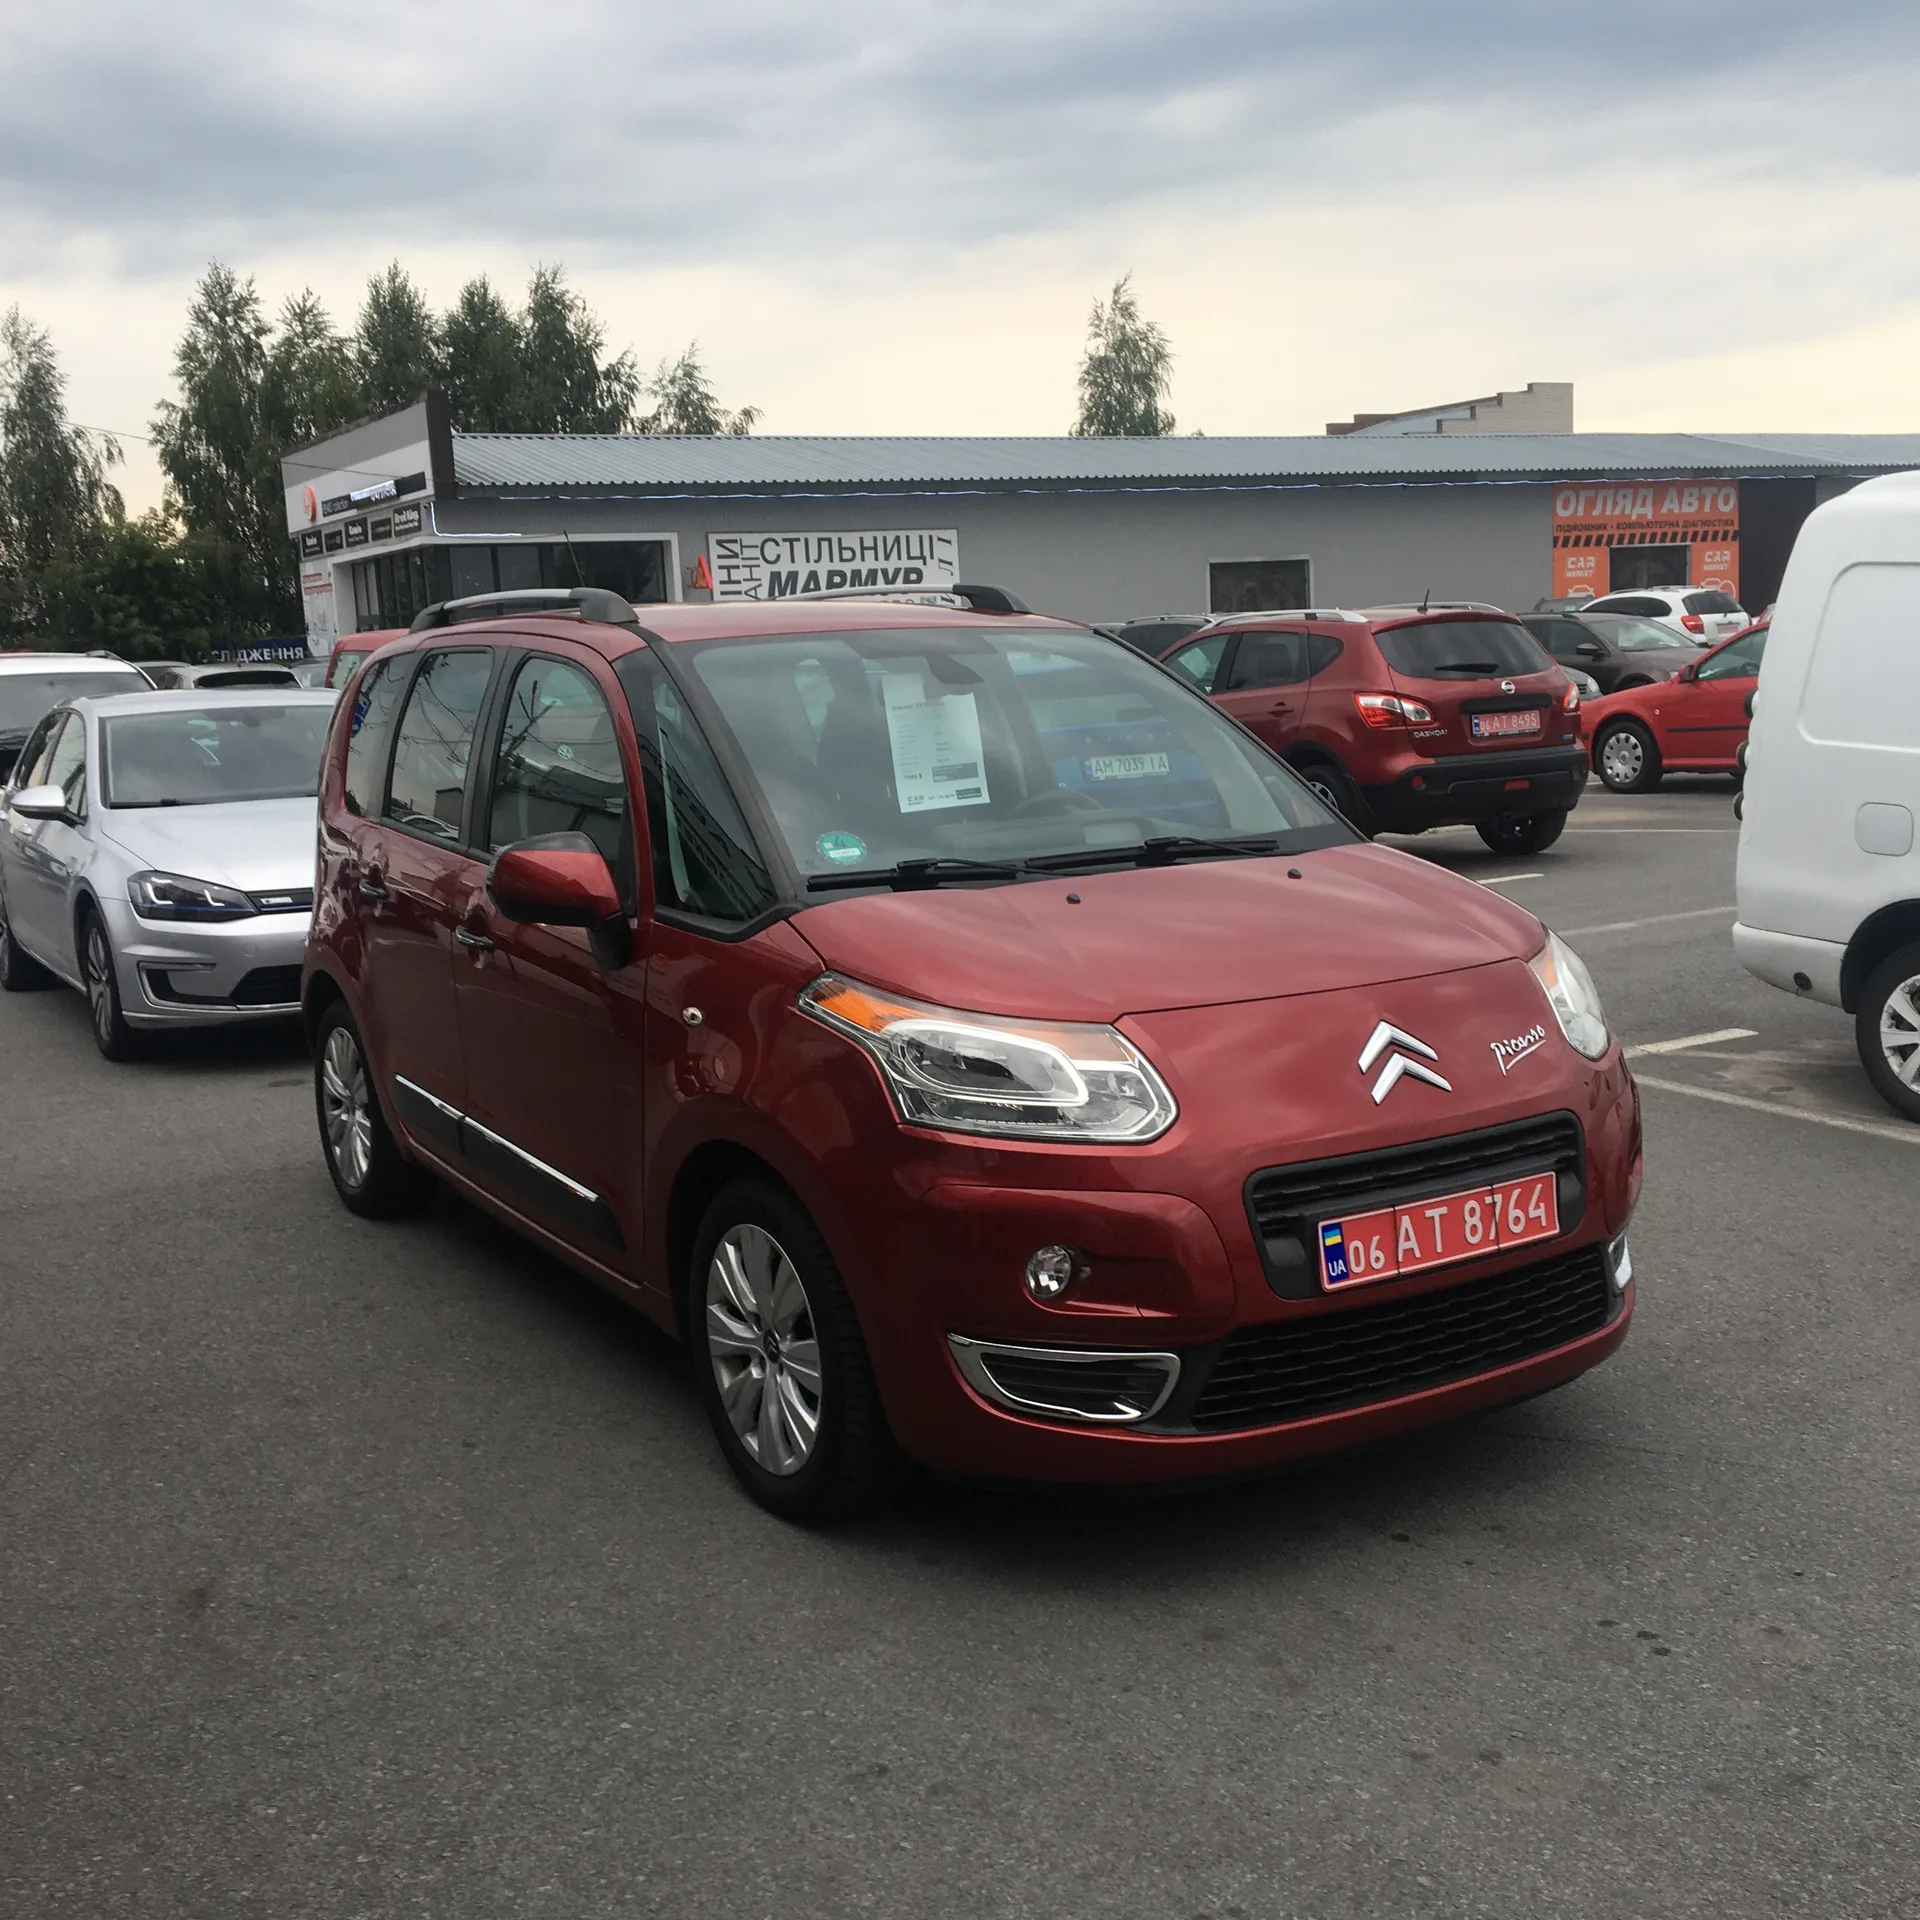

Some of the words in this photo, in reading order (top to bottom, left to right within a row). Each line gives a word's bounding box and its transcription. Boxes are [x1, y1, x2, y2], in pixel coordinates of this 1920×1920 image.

[1556, 487, 1654, 520] ОГЛЯД
[1661, 486, 1737, 514] АВТО
[760, 534, 935, 566] СТІЛЬНИЦІ
[1704, 550, 1731, 562] CAR
[1567, 556, 1596, 569] CAR
[1511, 713, 1537, 728] 8495
[1349, 1235, 1386, 1274] 06
[1397, 1206, 1448, 1263] AT
[1463, 1183, 1548, 1245] 8764
[1328, 1260, 1347, 1277] UA
